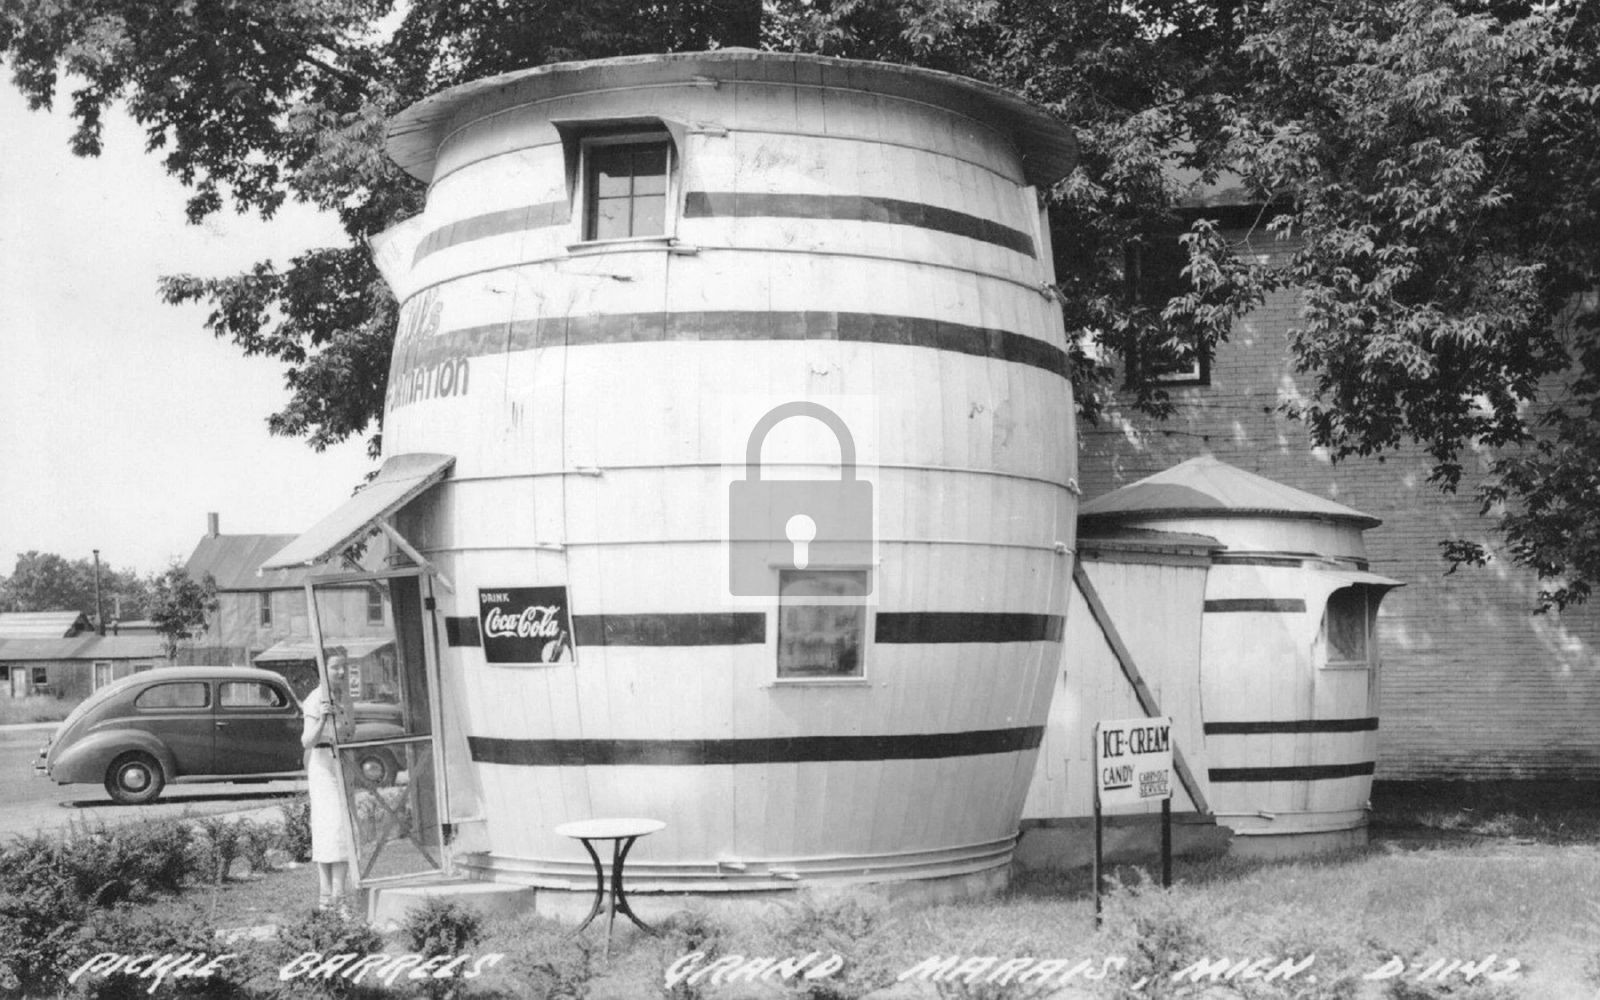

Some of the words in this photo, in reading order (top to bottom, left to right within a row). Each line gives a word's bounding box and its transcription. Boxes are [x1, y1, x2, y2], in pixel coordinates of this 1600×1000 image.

[481, 593, 510, 603] DRINK
[485, 605, 560, 638] Coca-Cola
[1102, 726, 1170, 758] ICE-CREAM
[1103, 765, 1135, 785] CANDY
